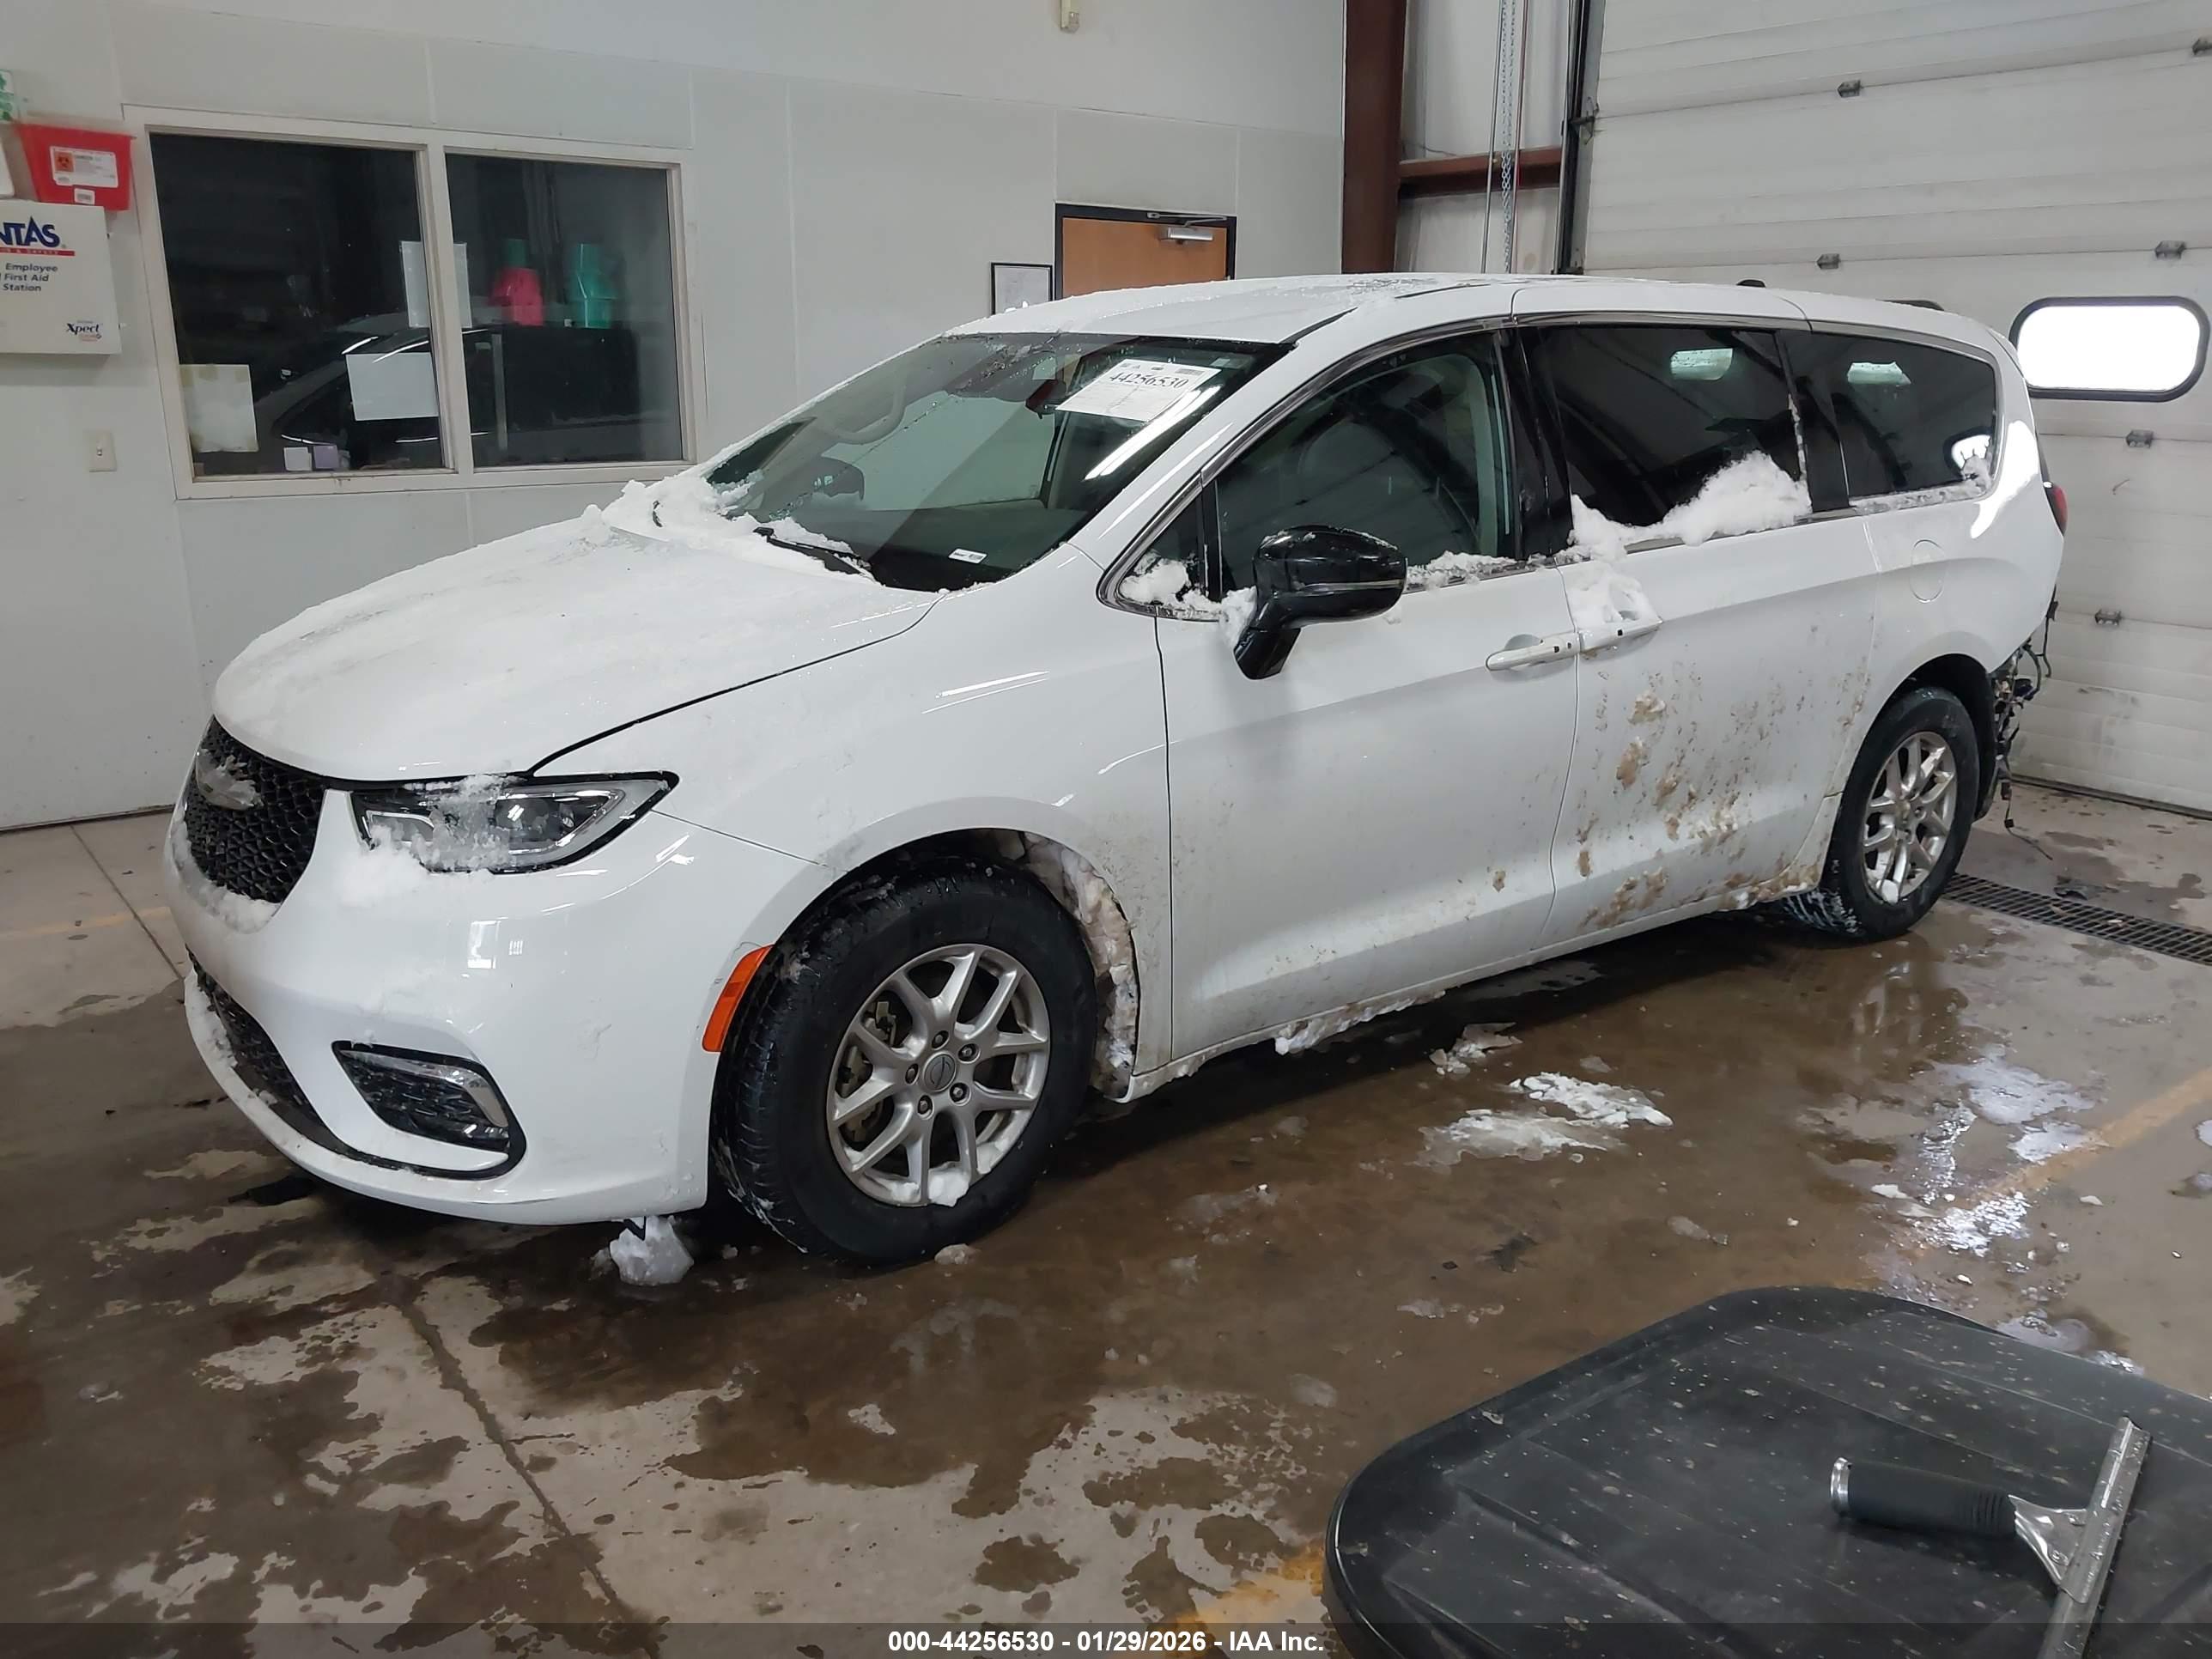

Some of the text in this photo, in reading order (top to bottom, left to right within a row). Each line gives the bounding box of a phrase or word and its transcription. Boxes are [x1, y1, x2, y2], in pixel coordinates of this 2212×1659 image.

[5, 263, 58, 272] Employee
[4, 273, 27, 282] First
[1109, 372, 1189, 388] 44256530
